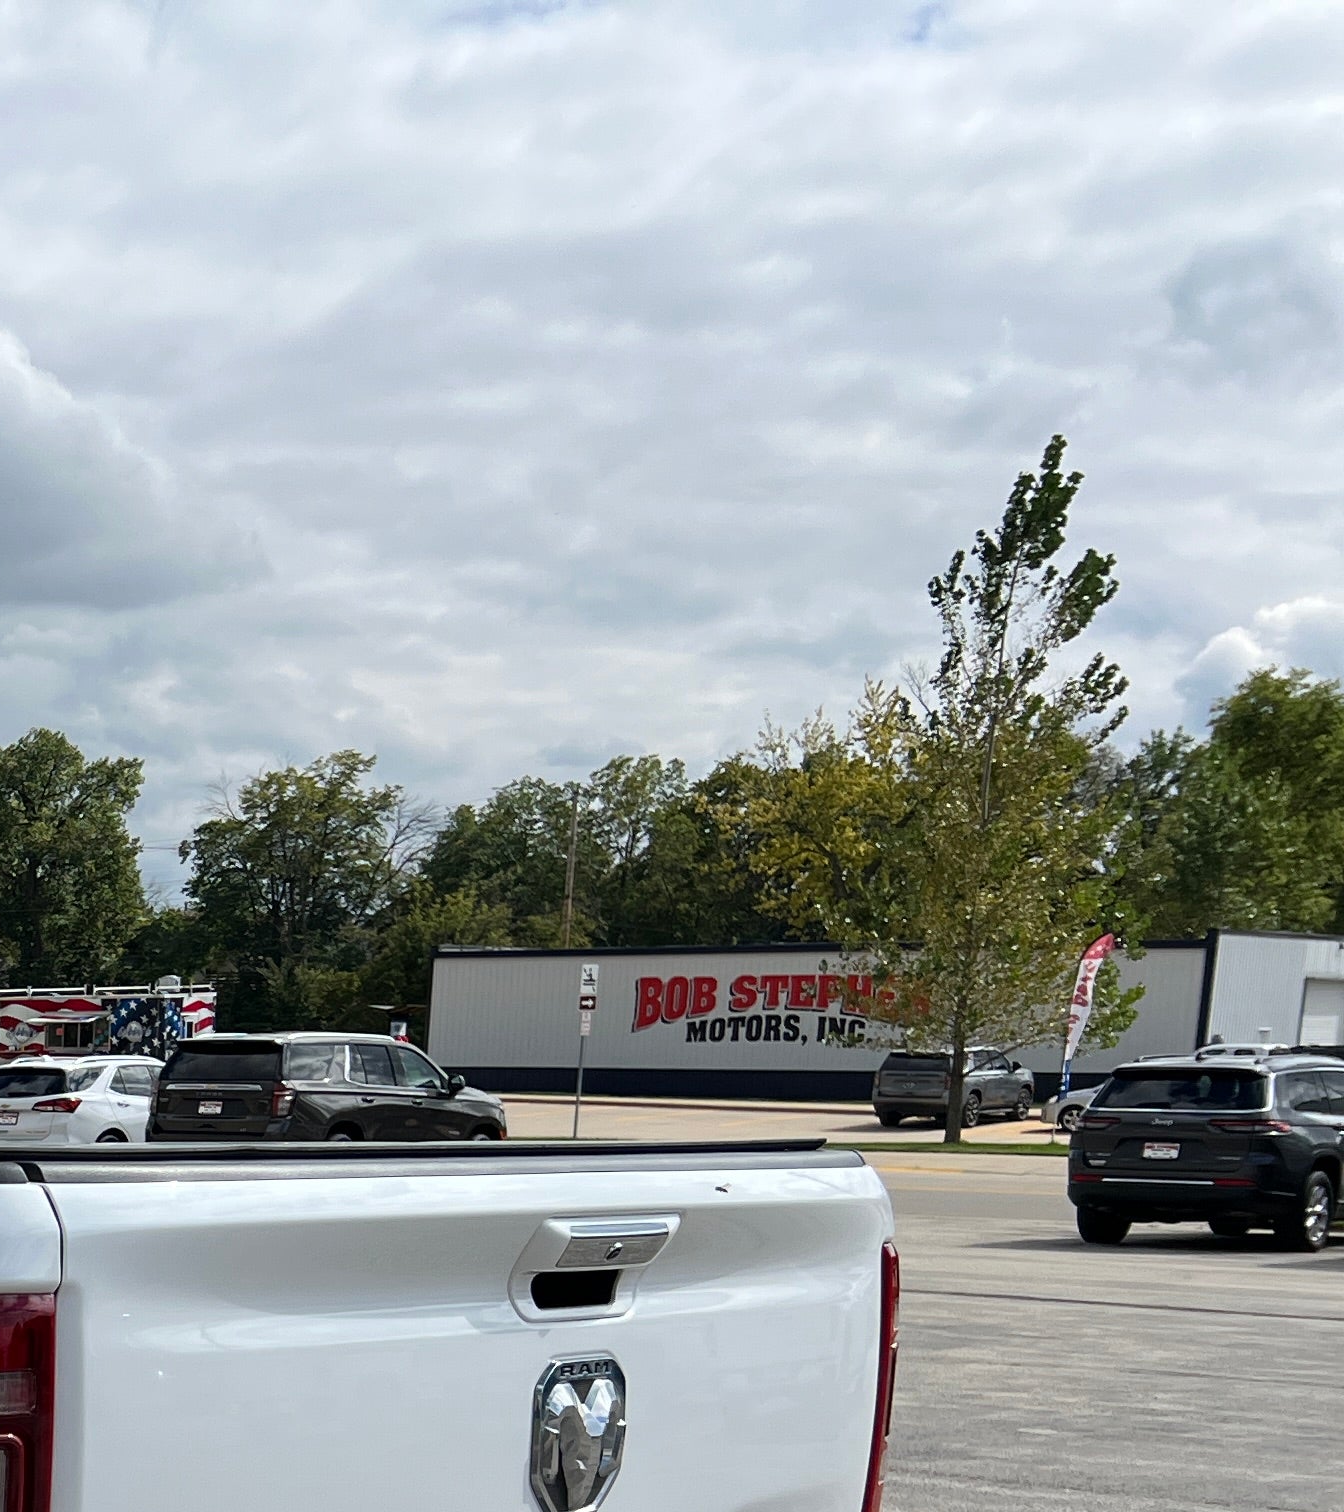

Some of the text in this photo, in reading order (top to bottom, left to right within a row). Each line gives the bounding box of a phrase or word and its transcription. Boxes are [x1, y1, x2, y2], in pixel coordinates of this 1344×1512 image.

[632, 975, 718, 1033] BOB
[686, 1015, 808, 1046] MOTORS,
[1151, 1118, 1174, 1128] Jeep
[560, 1360, 611, 1379] RAM
